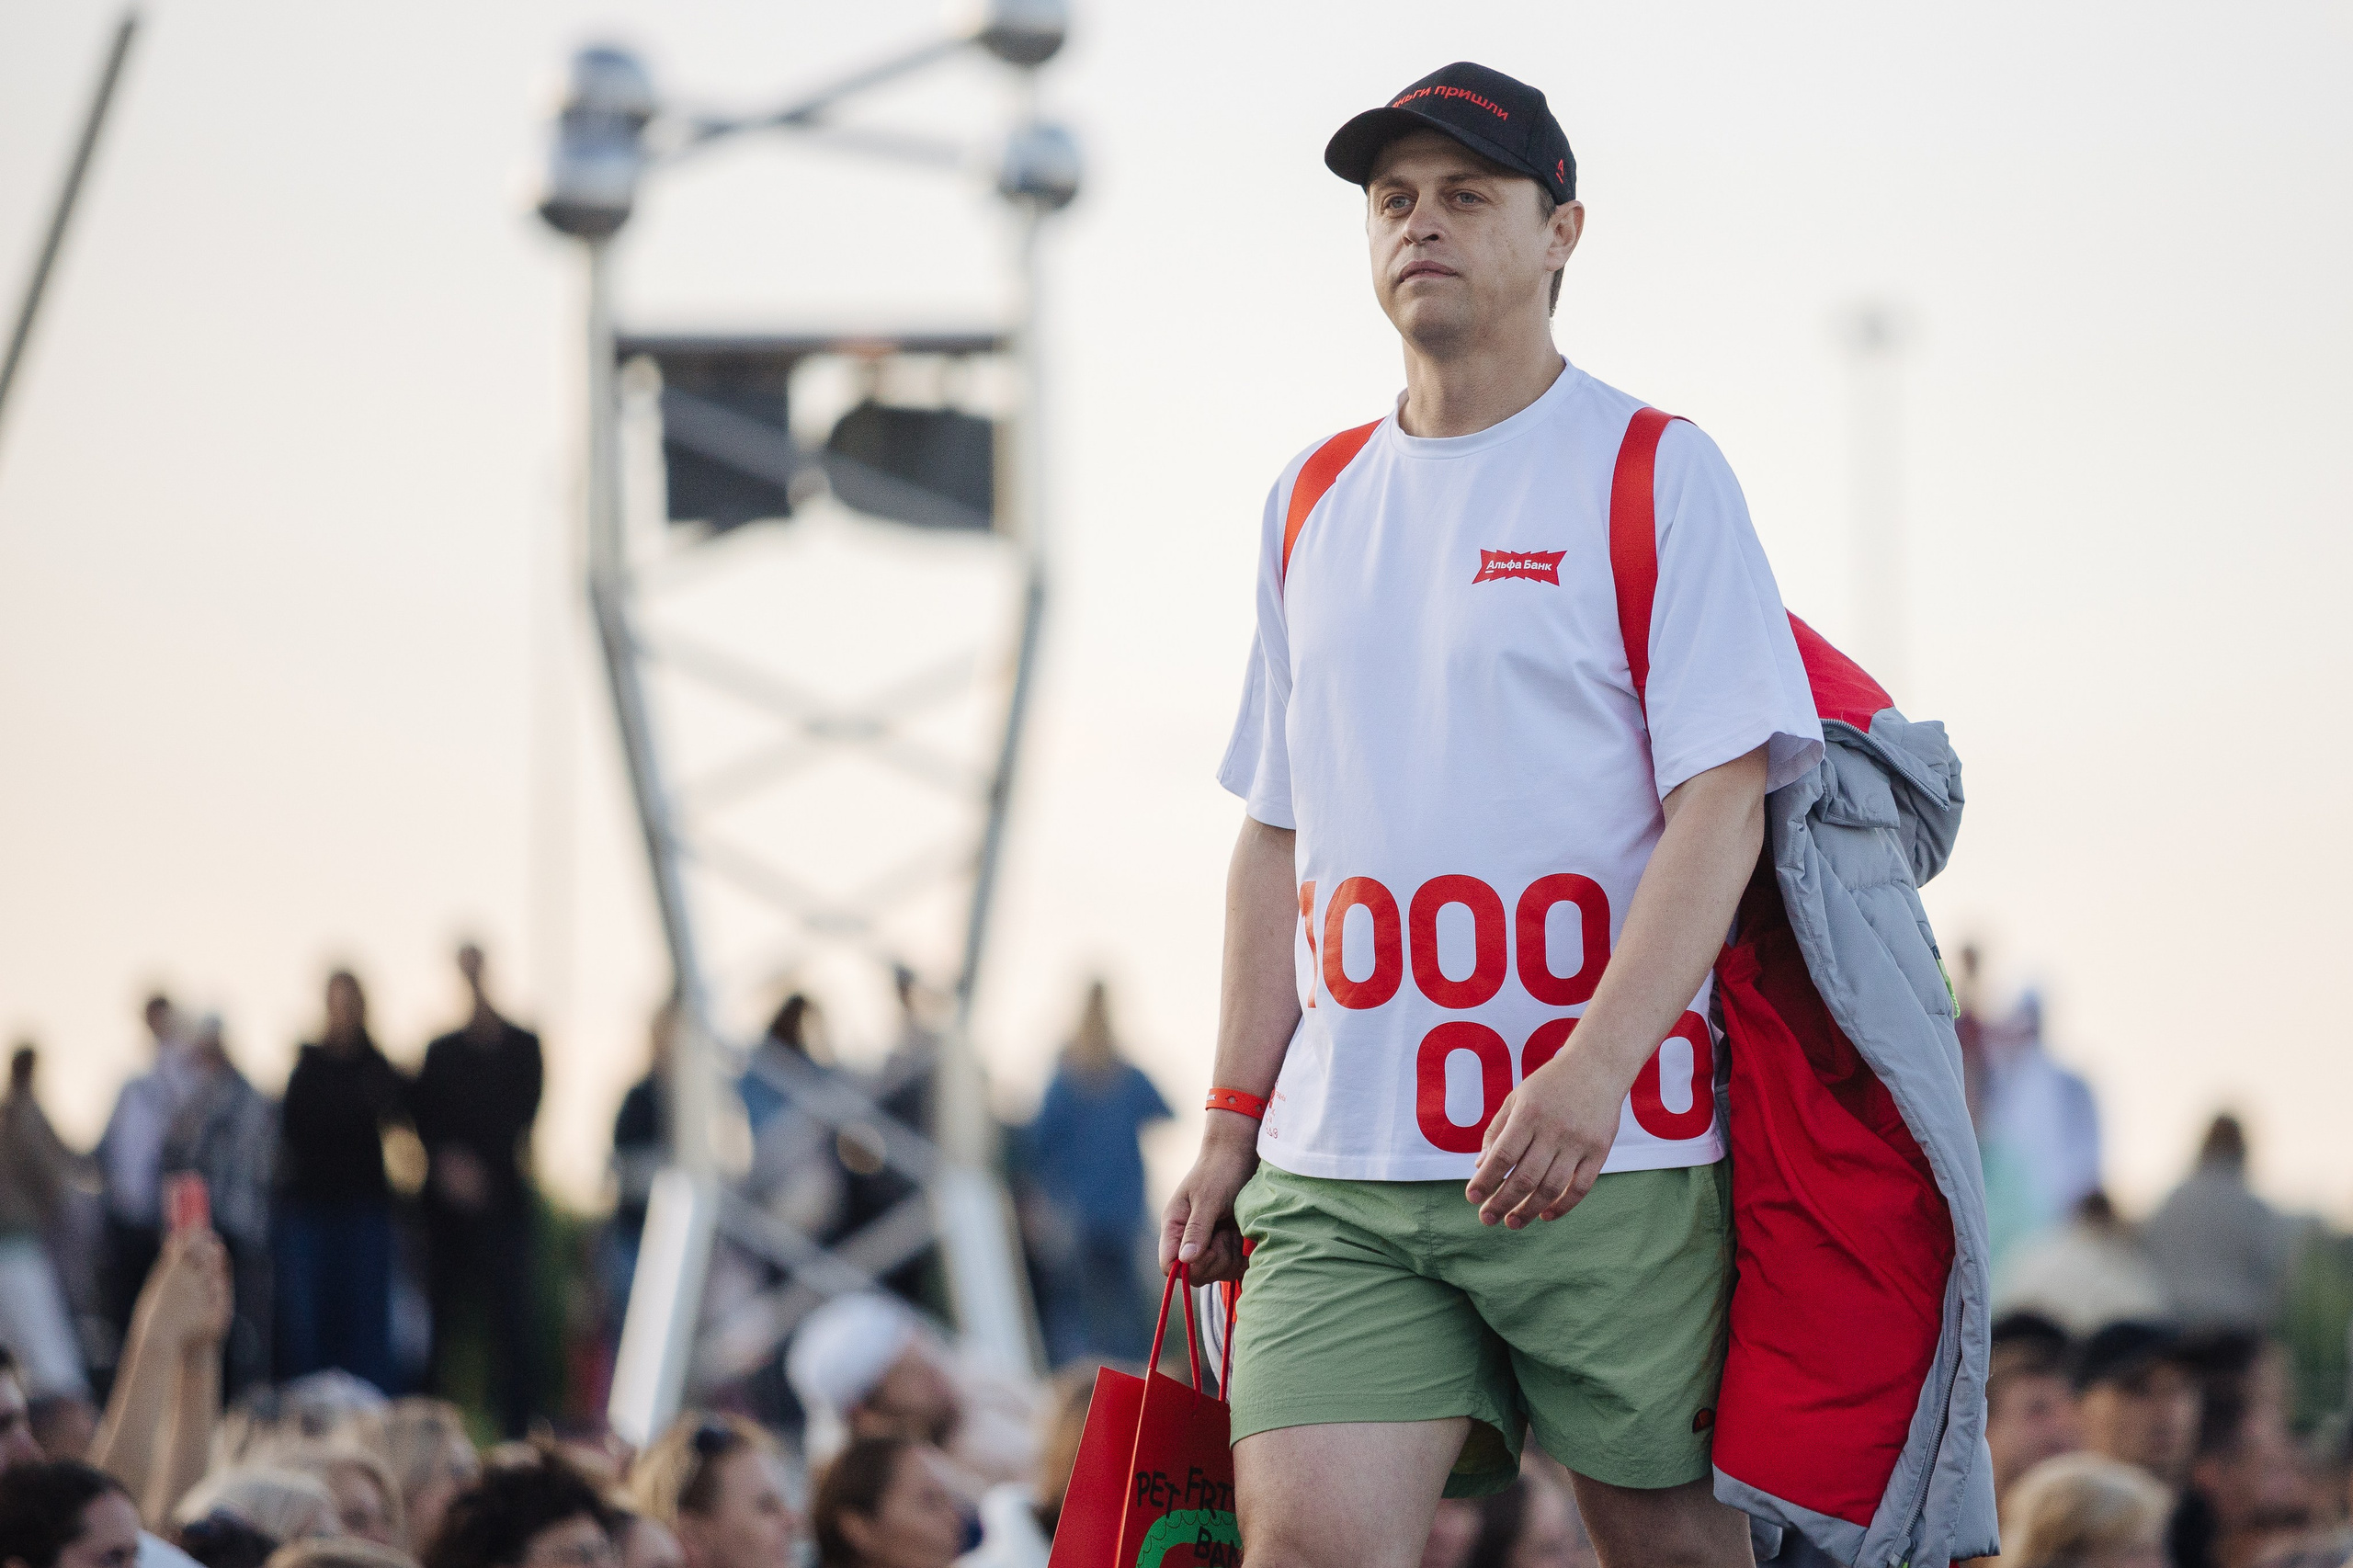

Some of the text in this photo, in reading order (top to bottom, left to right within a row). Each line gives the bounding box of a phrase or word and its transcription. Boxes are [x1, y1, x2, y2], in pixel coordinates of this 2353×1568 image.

[1434, 85, 1509, 121] пришли
[1485, 560, 1552, 572] Альфа Банк
[1135, 1466, 1236, 1519] PET FRT
